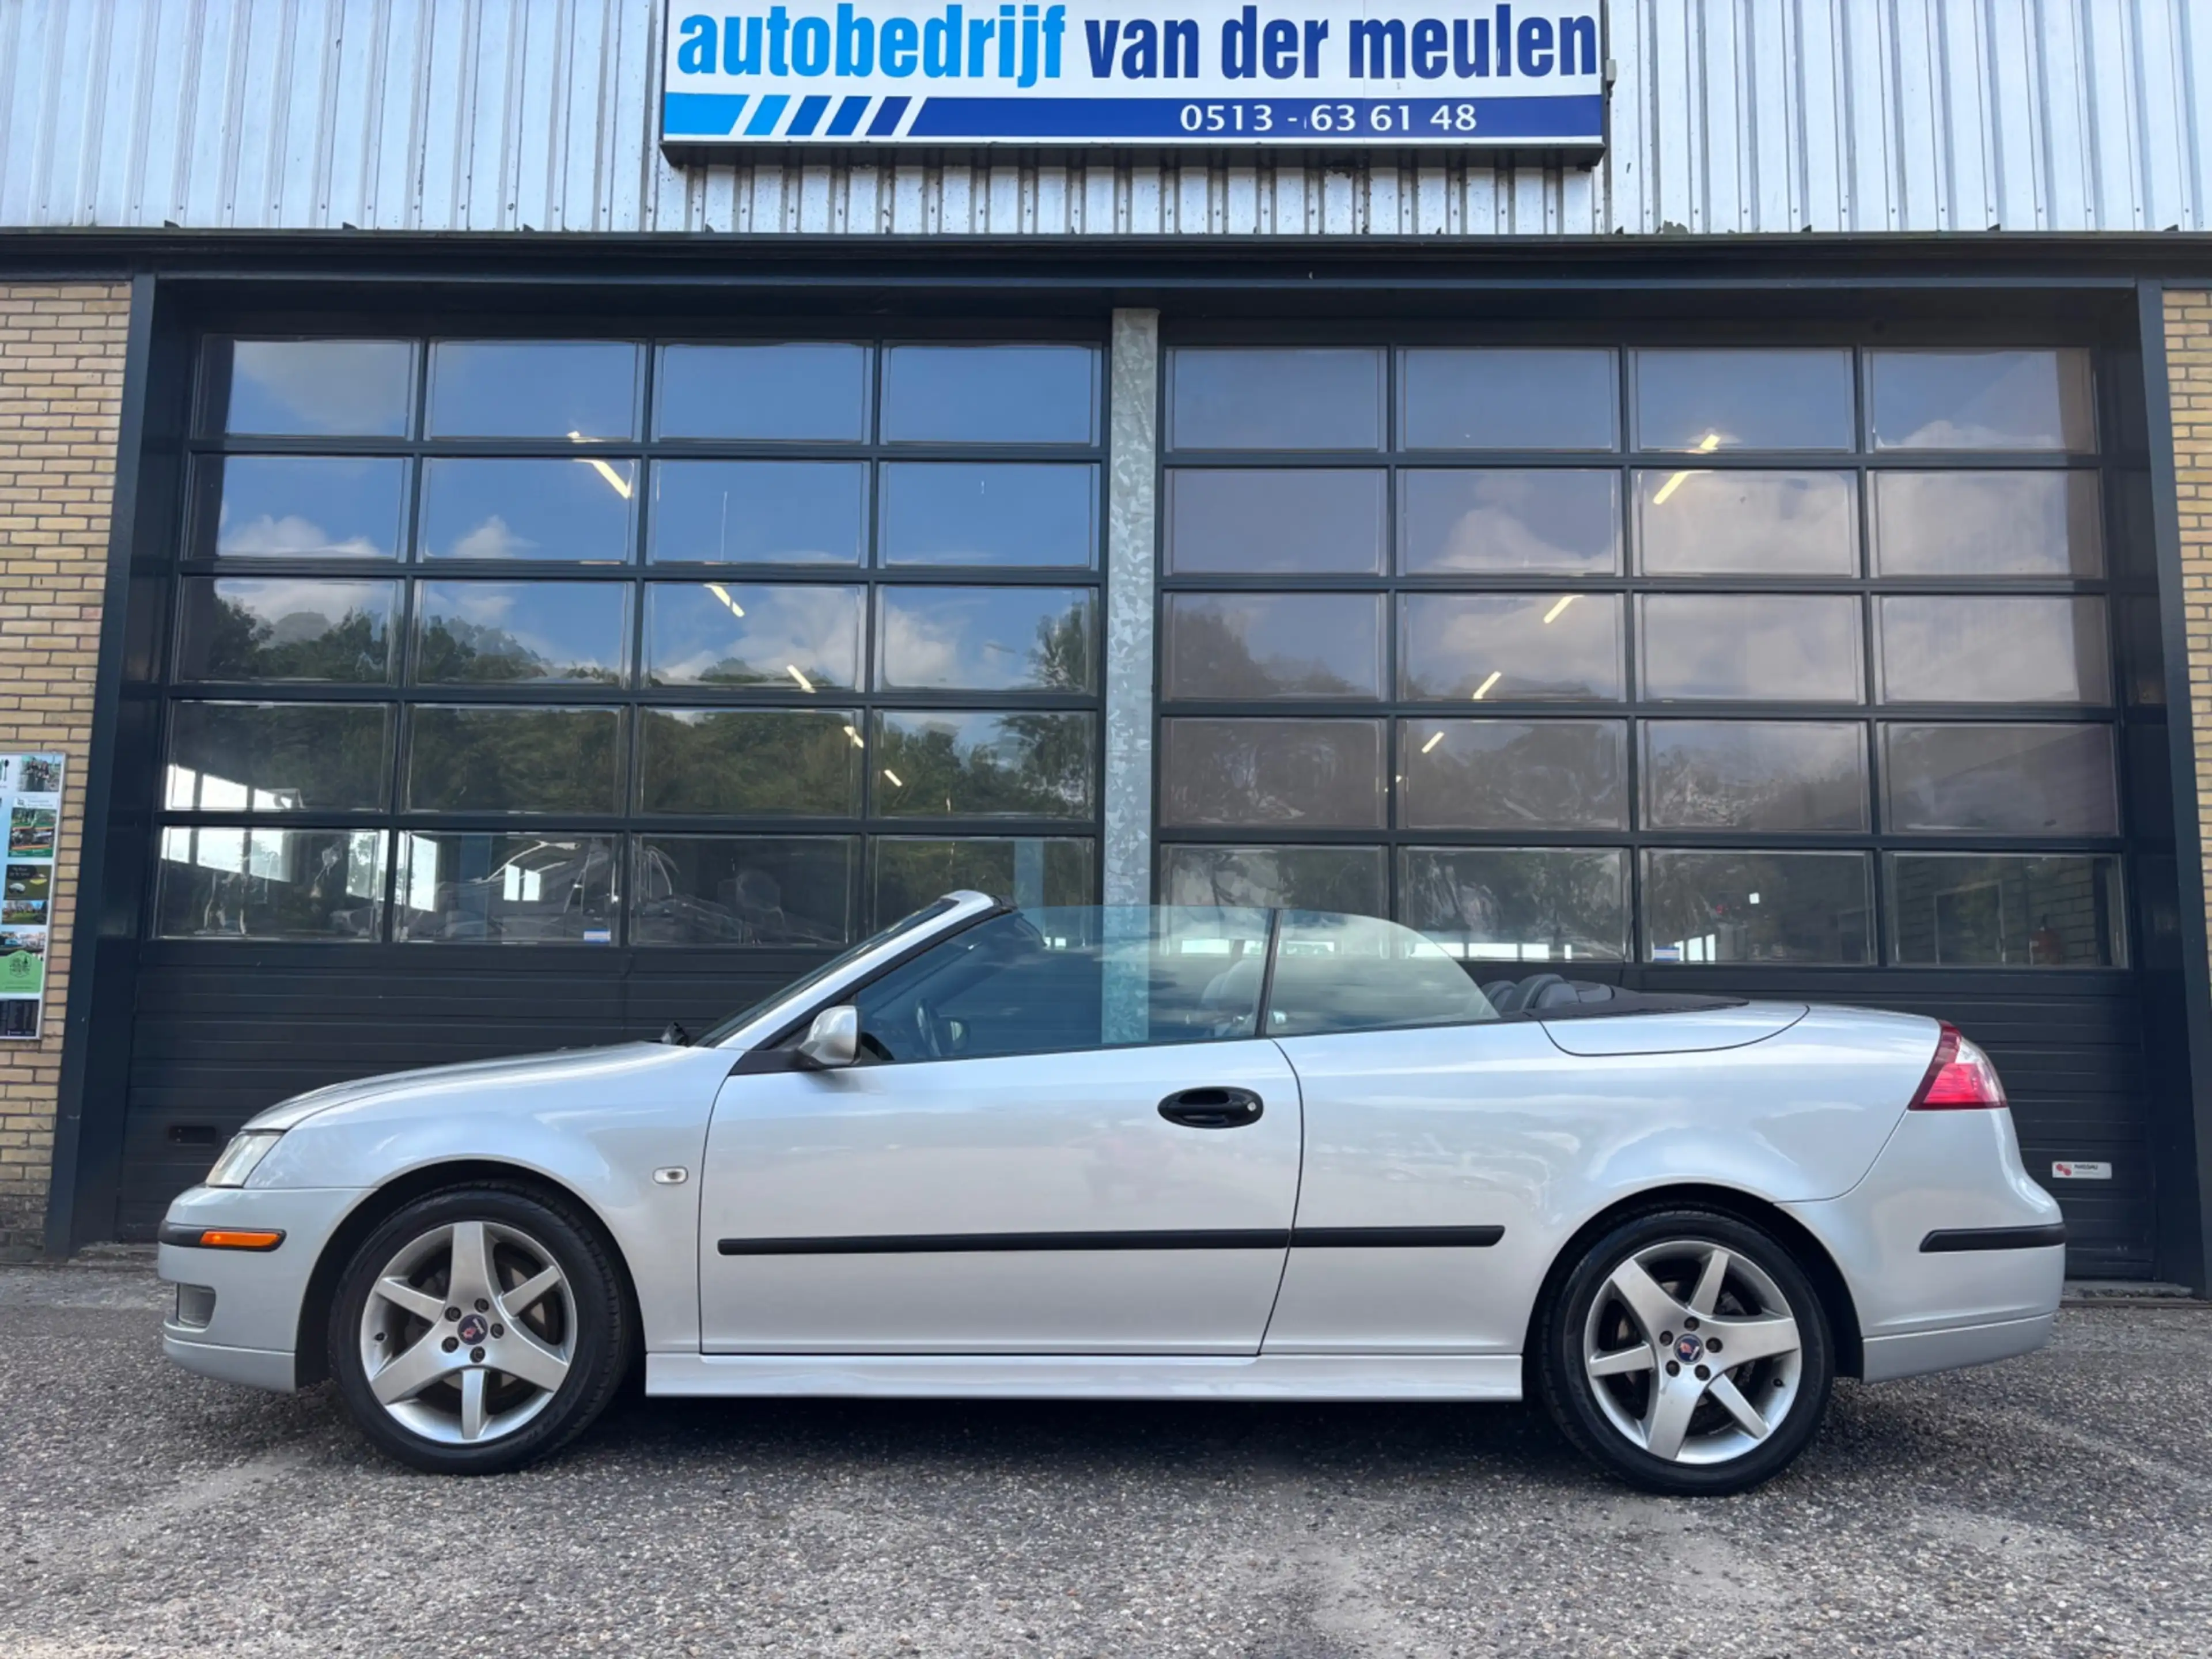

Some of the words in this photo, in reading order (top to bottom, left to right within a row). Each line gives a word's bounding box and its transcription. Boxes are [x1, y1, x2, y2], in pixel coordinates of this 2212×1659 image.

[677, 3, 1065, 88] autobedrijf
[1085, 19, 1199, 79] van
[1222, 5, 1328, 79] der
[1350, 4, 1596, 79] meulen
[1181, 105, 1272, 130] 0513
[1312, 105, 1355, 131] 63
[1371, 105, 1408, 131] 61
[1430, 105, 1476, 130] 48
